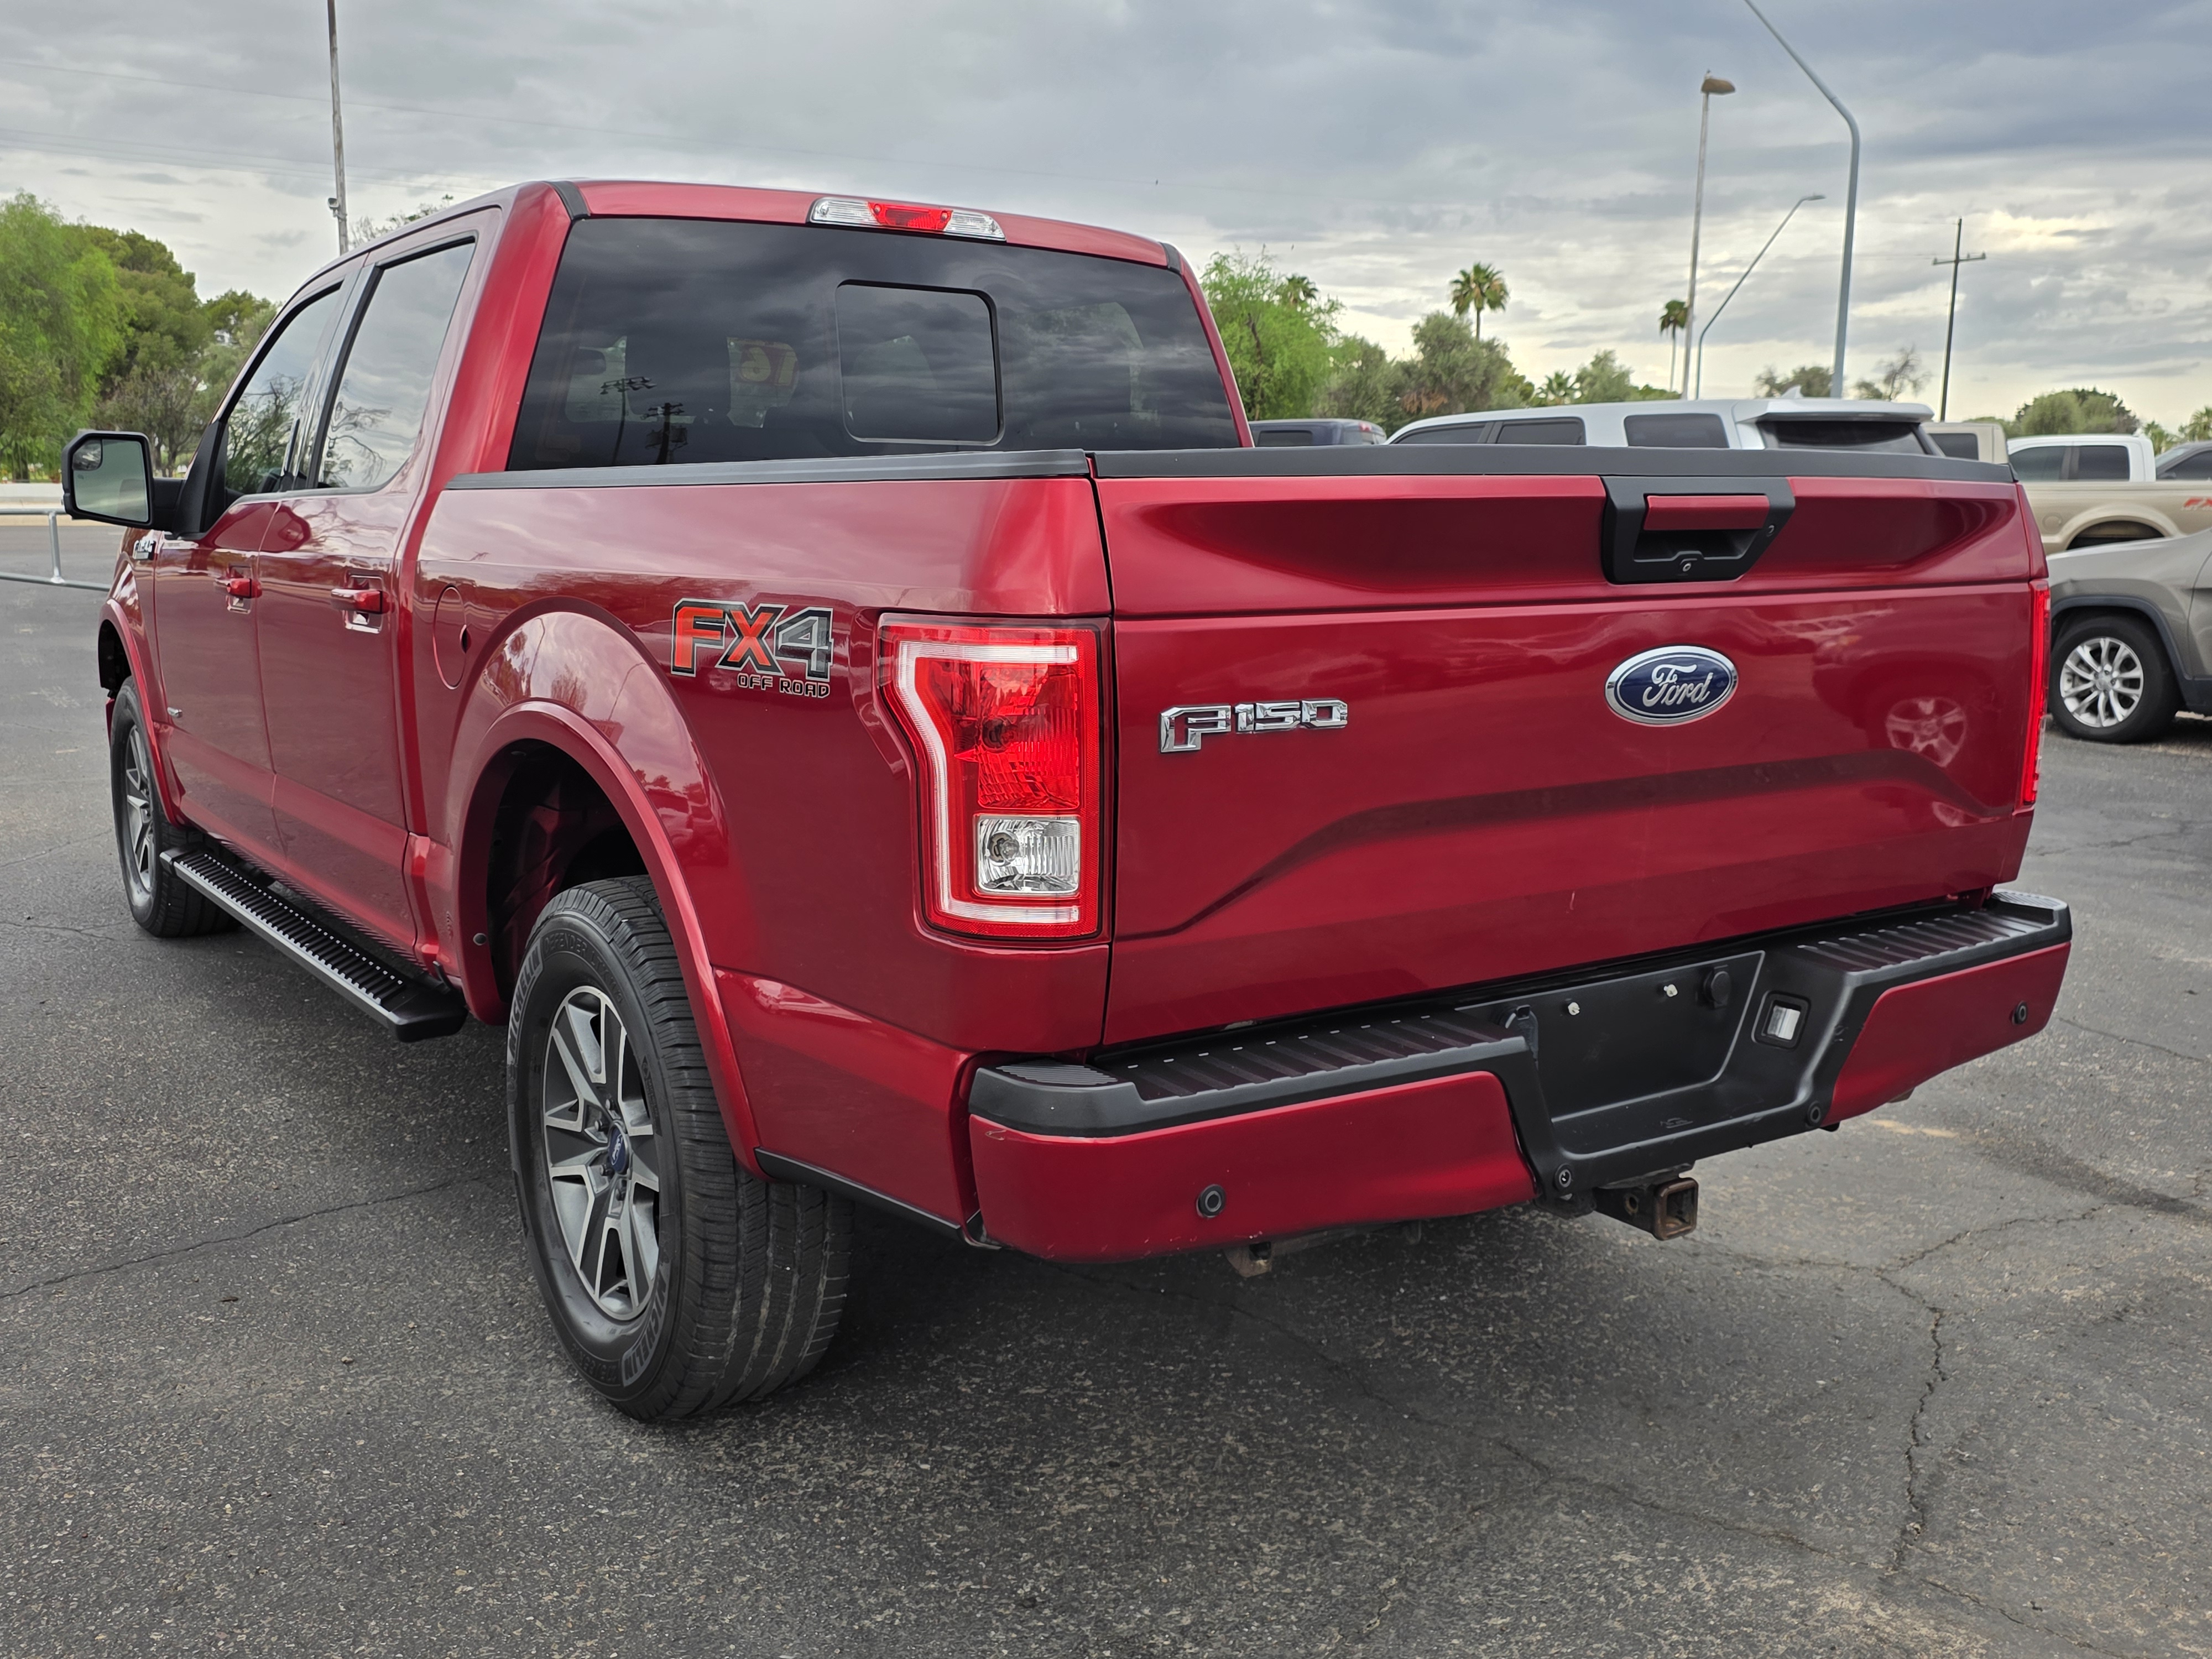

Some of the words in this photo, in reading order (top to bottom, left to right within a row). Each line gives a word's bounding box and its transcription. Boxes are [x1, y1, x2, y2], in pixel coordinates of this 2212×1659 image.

[671, 598, 833, 682] FX4
[737, 673, 773, 690] OFF
[779, 677, 830, 698] ROAD
[1642, 664, 1713, 707] Ford
[1160, 698, 1348, 753] F150
[544, 932, 588, 958] DEFENDER
[509, 945, 541, 1057] MICHELIN
[624, 1271, 667, 1379] MICHELIN
